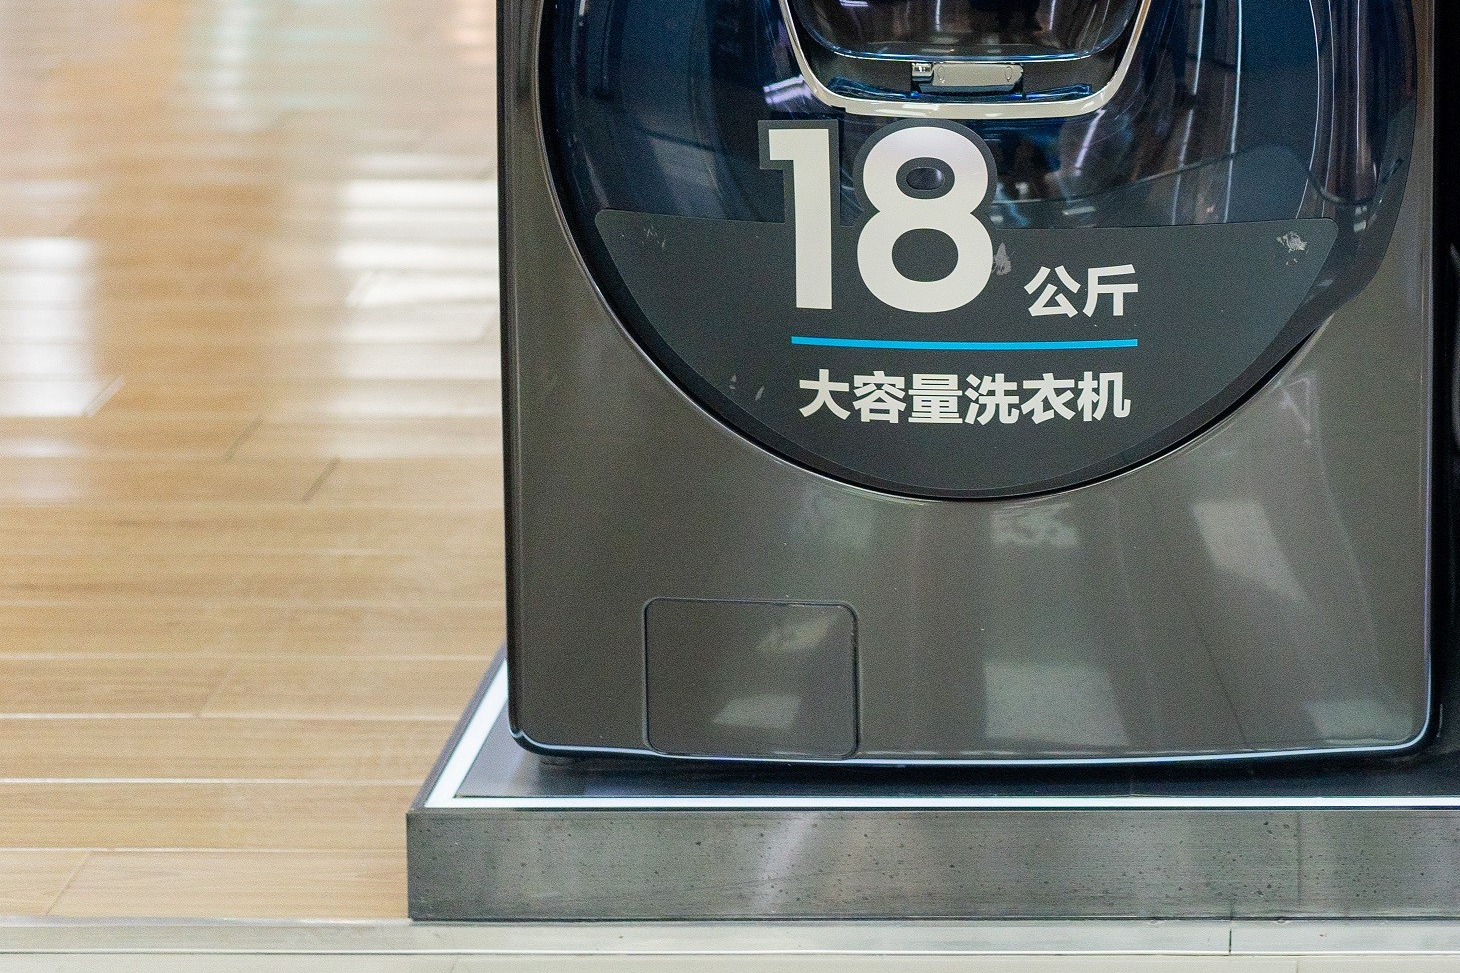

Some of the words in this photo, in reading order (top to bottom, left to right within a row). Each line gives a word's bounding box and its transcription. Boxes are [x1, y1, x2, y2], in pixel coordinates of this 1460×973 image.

[768, 126, 994, 313] 18
[1024, 263, 1139, 318] 公斤
[798, 368, 1132, 426] 大容量洗衣机
